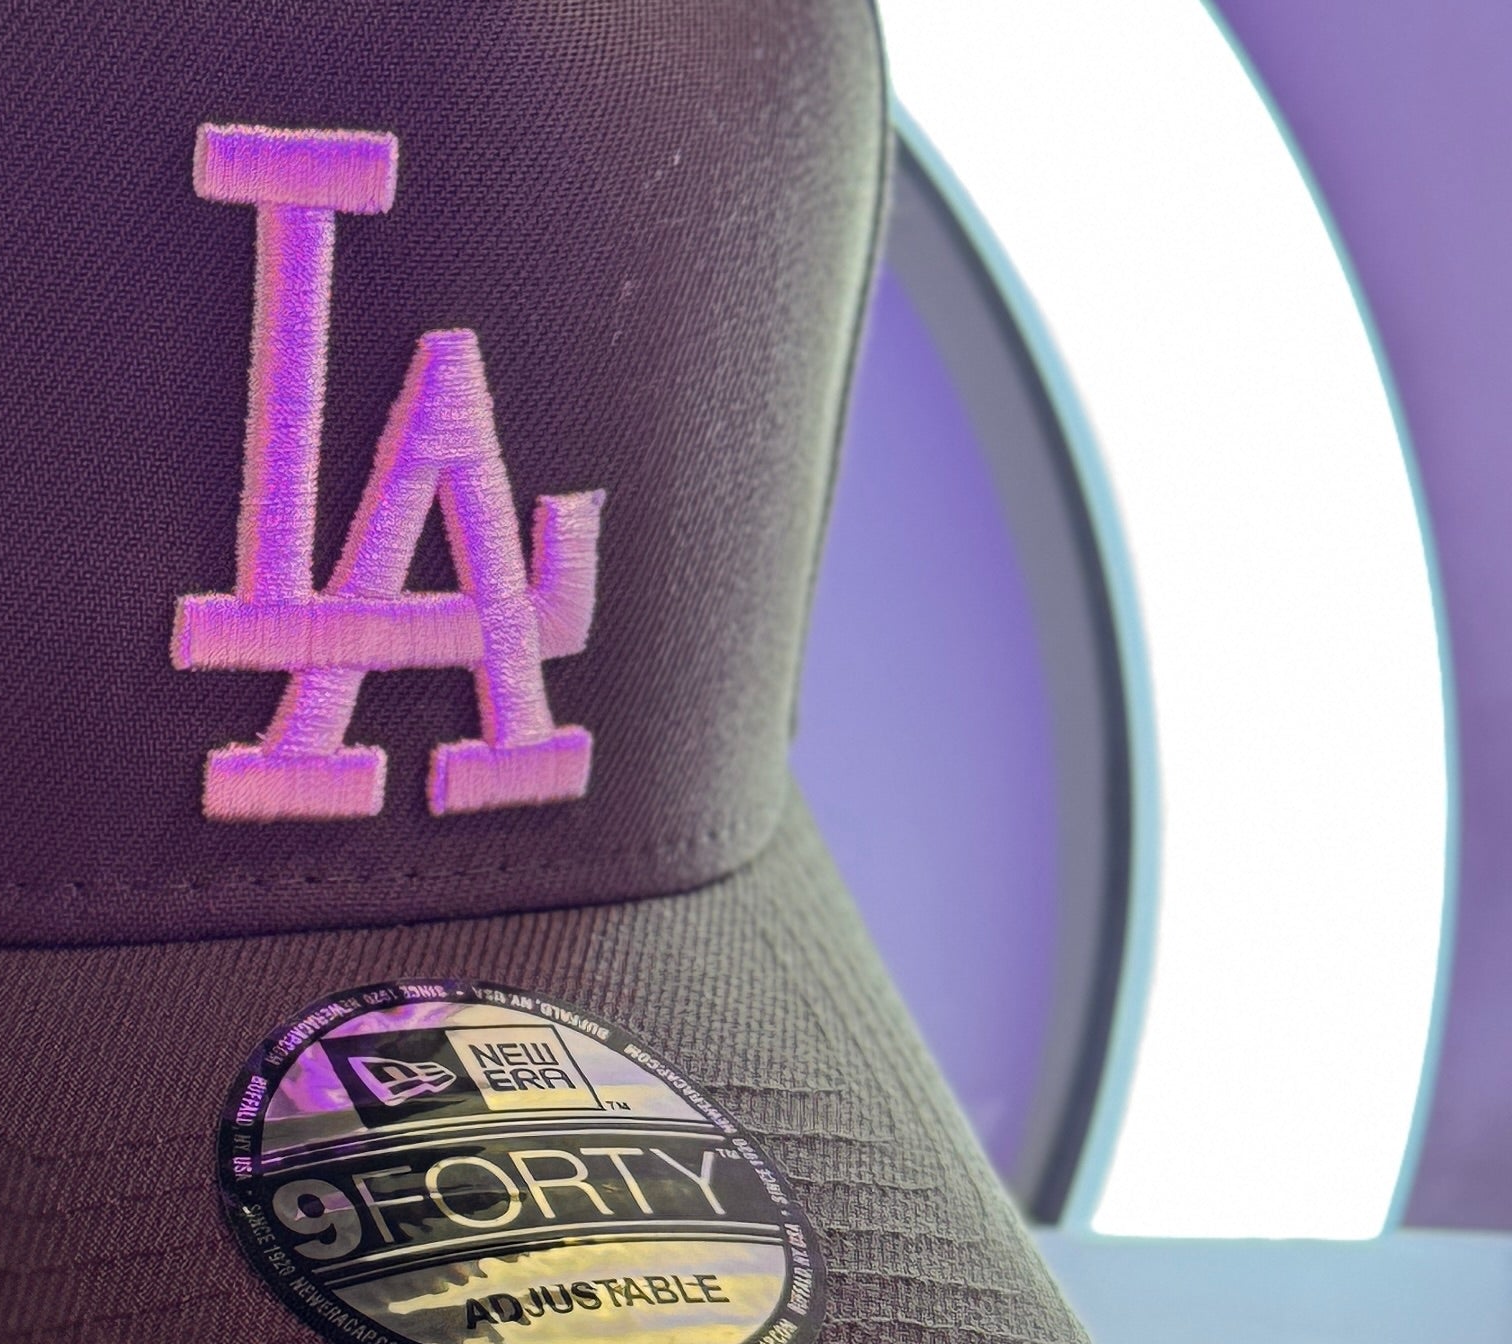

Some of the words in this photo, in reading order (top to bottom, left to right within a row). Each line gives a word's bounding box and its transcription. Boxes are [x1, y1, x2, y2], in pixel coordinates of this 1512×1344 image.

[170, 121, 608, 824] LA
[468, 1042, 559, 1069] NEW
[483, 1067, 577, 1092] ERA
[271, 1146, 726, 1260] 9FORTY
[465, 1273, 730, 1330] ADJUSTABLE
